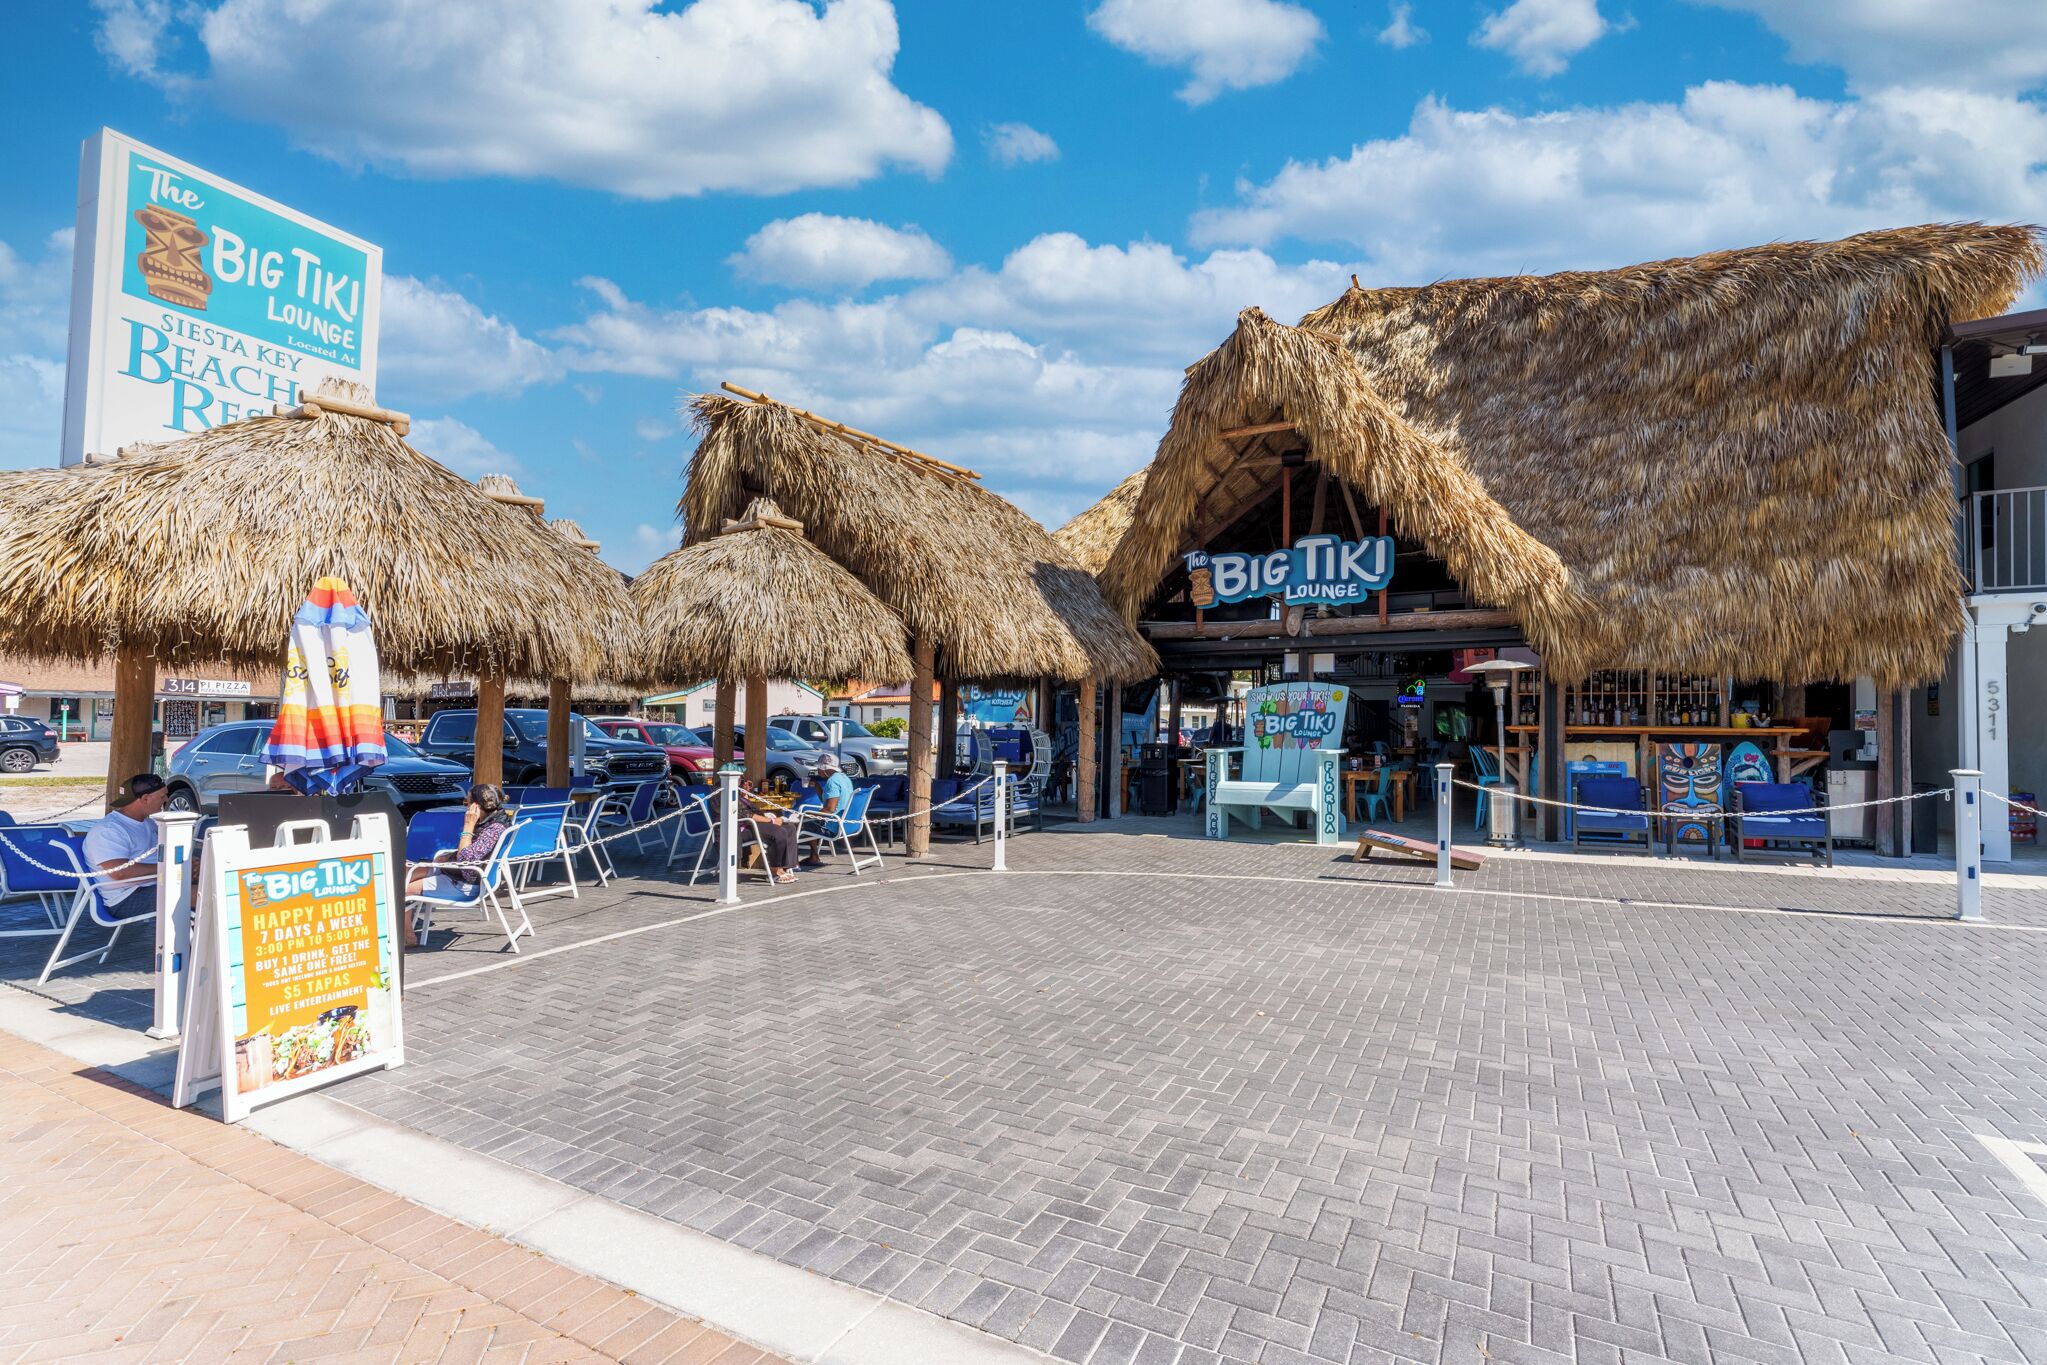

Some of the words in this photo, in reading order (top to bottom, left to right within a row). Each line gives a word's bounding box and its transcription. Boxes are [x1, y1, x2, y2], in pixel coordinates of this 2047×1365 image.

[137, 164, 205, 210] The
[211, 225, 284, 289] BIG
[292, 247, 360, 322] TIKI
[267, 296, 355, 350] LOUNGE
[161, 313, 249, 358] SIESTA
[256, 343, 303, 373] KEY
[287, 335, 337, 360] Located
[341, 351, 356, 365] At
[117, 316, 300, 408] BEACH
[1183, 552, 1209, 573] The
[1212, 552, 1289, 597] BIG
[1295, 538, 1386, 583] TIKI
[1285, 583, 1359, 600] LOUNGE
[168, 679, 196, 693] 3.14
[200, 681, 210, 689] PI
[216, 682, 248, 690] PIZZA
[1251, 691, 1274, 702] SHOW
[1275, 691, 1286, 701] US
[1288, 690, 1307, 702] YOUR
[991, 698, 1014, 706] KITCHEN
[1252, 712, 1265, 721] The
[1265, 714, 1298, 734] BIG
[1299, 710, 1334, 733] TIKI
[1293, 729, 1322, 738] LOUNGE
[1209, 754, 1217, 806] SIESTA
[1324, 760, 1336, 834] FLORIDA
[1209, 812, 1218, 836] KEY
[263, 870, 318, 900] BIG
[318, 860, 370, 885] TIKI
[314, 884, 358, 898] LOUNGE
[253, 905, 315, 931] HAPPY
[321, 897, 367, 919] HOUR
[260, 931, 268, 944] 7
[274, 923, 312, 941] DAYS
[316, 920, 325, 933] A
[329, 913, 364, 931] WEEK
[255, 942, 283, 957] 3:00
[288, 938, 305, 950] PM
[309, 934, 323, 946] TO
[326, 929, 350, 943] 5:00
[354, 925, 369, 937] PM
[255, 957, 278, 972] BUY
[282, 956, 287, 966] 1
[331, 943, 349, 956] GET
[352, 938, 371, 951] THE
[273, 963, 303, 979] SAME
[306, 958, 327, 972] ONE
[330, 951, 357, 966] FREE!
[292, 972, 315, 982] INCLUDE
[269, 1003, 291, 1017] LIVE
[293, 984, 364, 1010] ENTERTAINMENT
[283, 984, 301, 1001] $5
[306, 972, 350, 994] TAPAS
